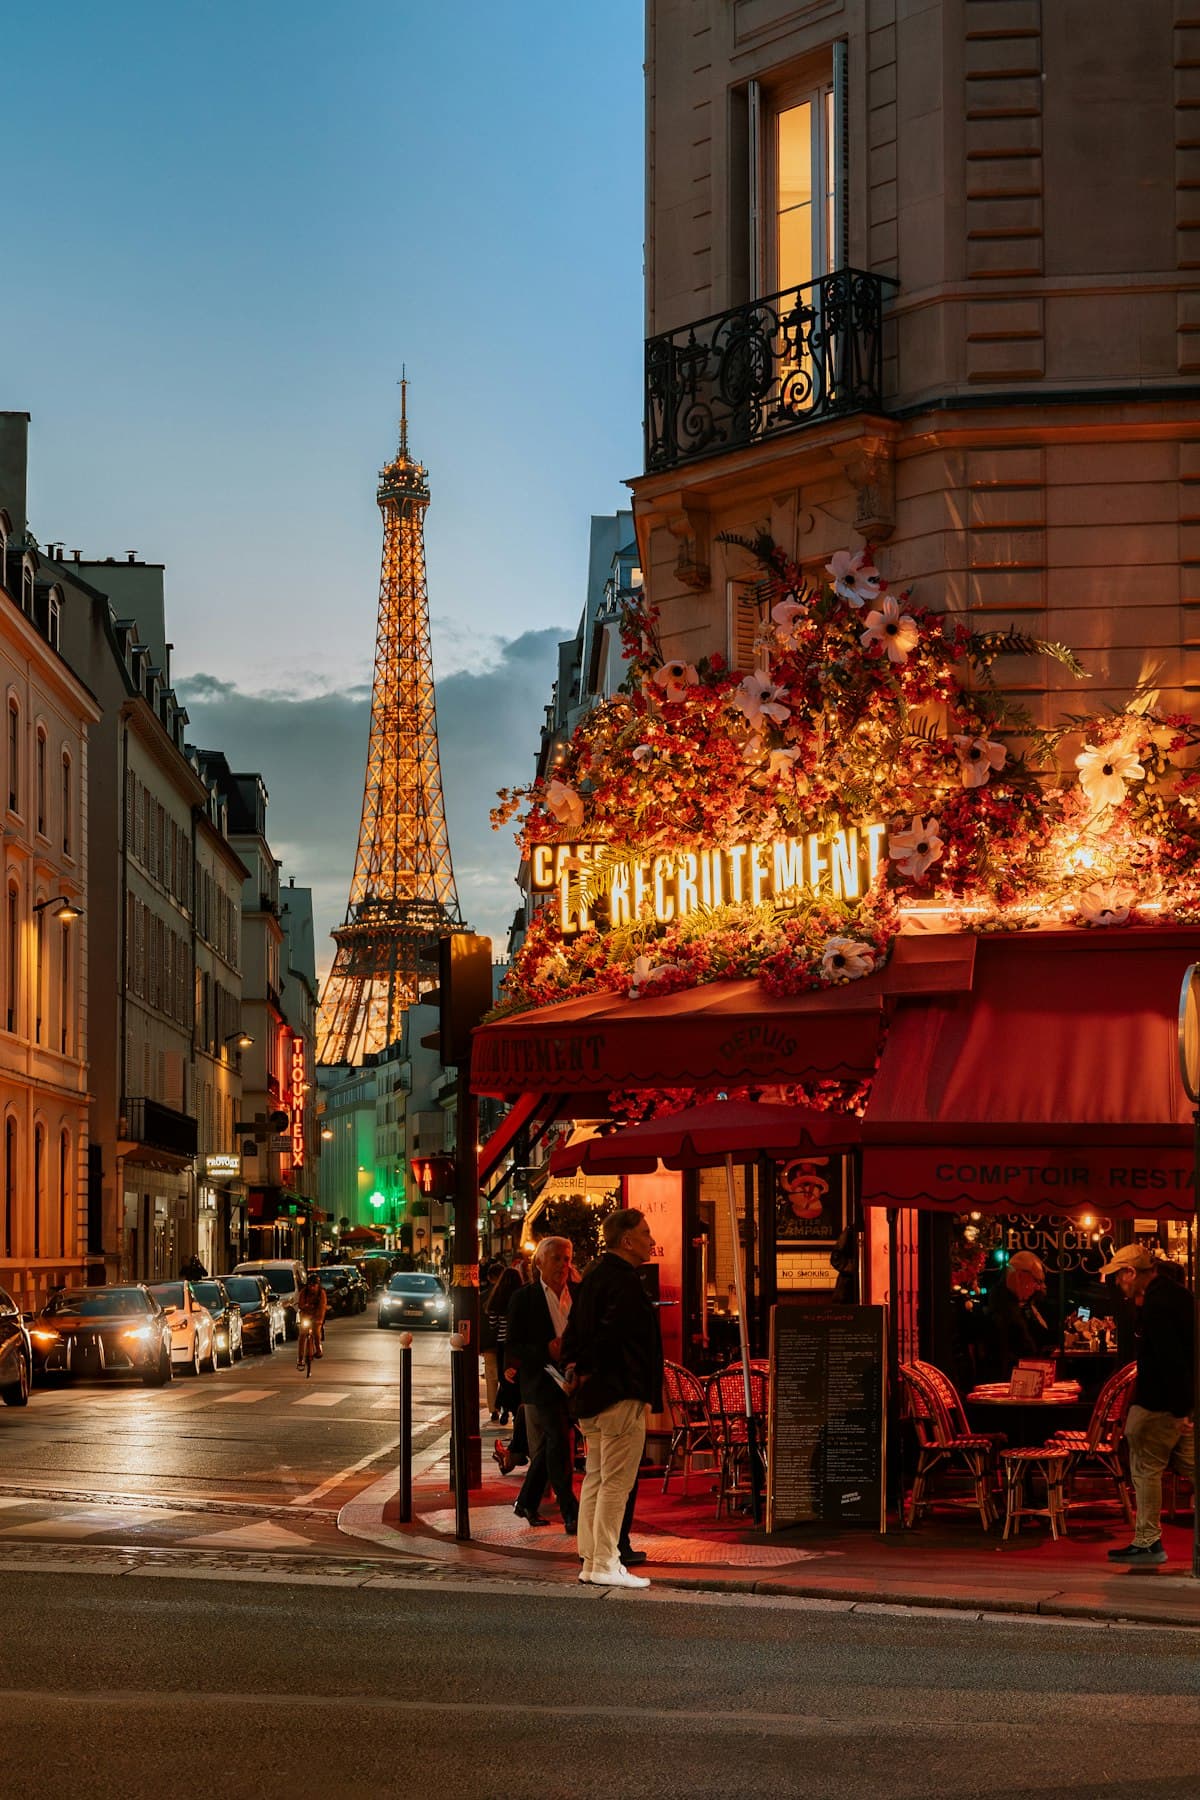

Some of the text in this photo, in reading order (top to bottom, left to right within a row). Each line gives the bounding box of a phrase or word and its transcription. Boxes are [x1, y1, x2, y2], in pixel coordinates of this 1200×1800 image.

[612, 823, 885, 930] RECRUTEMENT
[719, 1024, 798, 1060] DEPUIS
[292, 1038, 304, 1167] THOUMIEUX
[935, 1163, 1089, 1186] COMPTOIR
[776, 1225, 833, 1236] CAMPARI
[988, 1230, 1092, 1250] RUNCH
